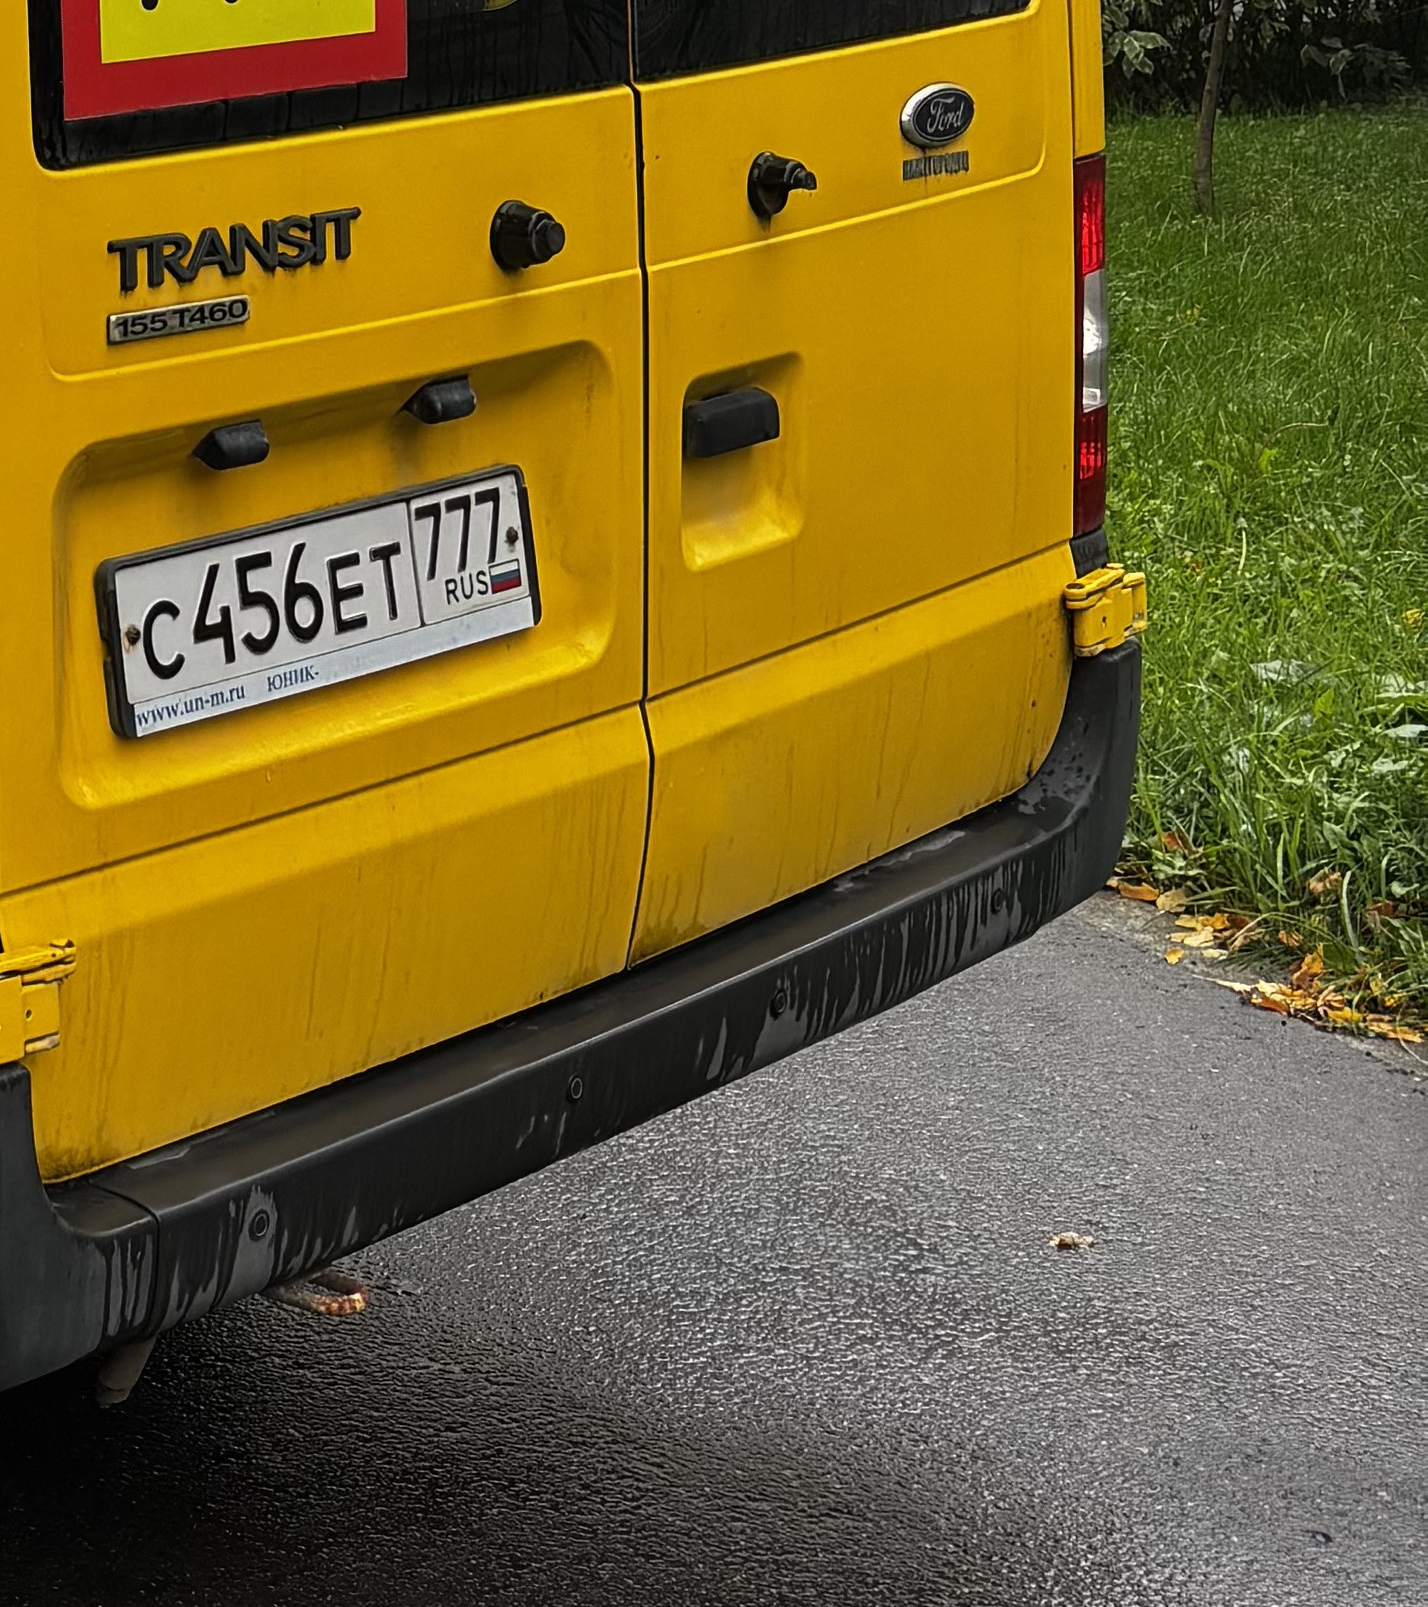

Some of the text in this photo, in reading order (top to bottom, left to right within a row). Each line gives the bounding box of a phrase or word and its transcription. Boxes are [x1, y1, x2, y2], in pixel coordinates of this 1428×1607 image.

[926, 96, 965, 134] Ford
[107, 206, 362, 293] TRANSIT
[116, 298, 248, 338] 155 T460
[414, 487, 501, 582] 777
[444, 569, 490, 606] RUS
[137, 685, 246, 727] www.un-m.ru
